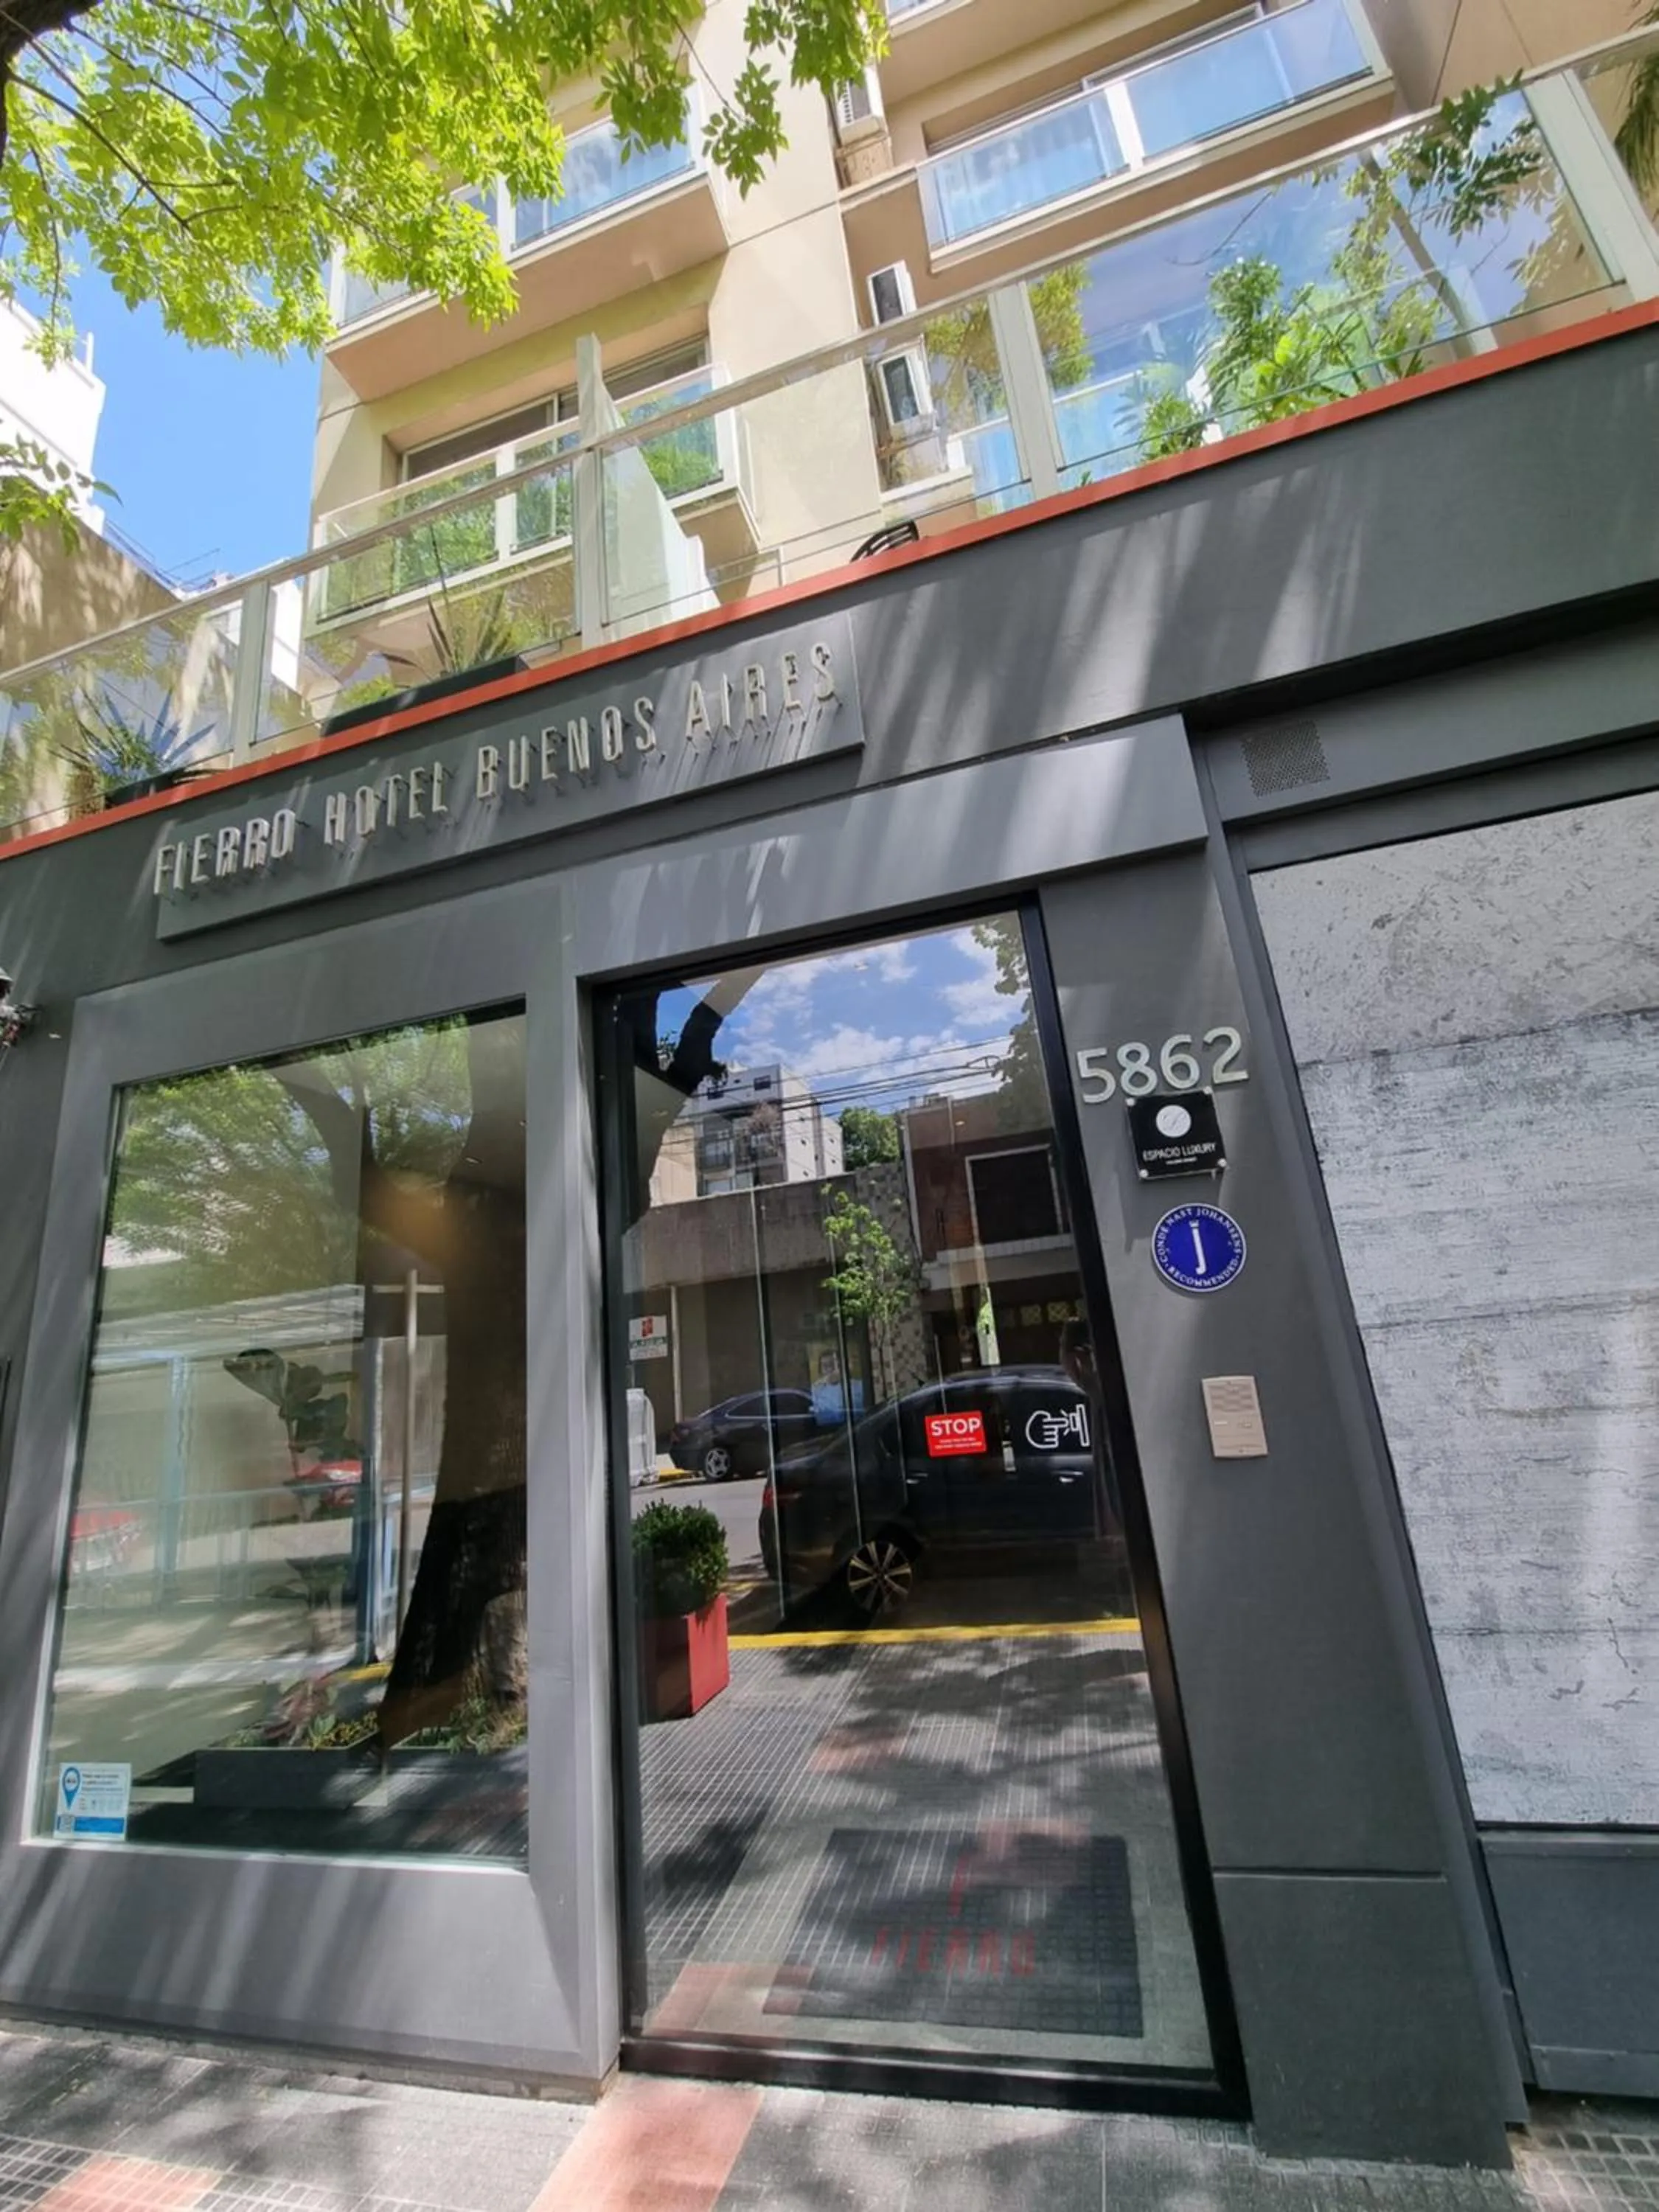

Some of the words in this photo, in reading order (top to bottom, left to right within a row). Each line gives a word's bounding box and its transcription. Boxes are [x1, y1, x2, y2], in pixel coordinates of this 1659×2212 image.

[153, 809, 296, 895] FIERRO
[324, 762, 448, 845] HOTEL
[476, 696, 656, 801] BUENOS
[686, 641, 838, 741] AIRES
[1077, 1026, 1249, 1103] 5862
[1142, 1147, 1180, 1162] ESPACIO
[1181, 1142, 1216, 1157] LUXURY
[931, 1416, 981, 1437] STOP
